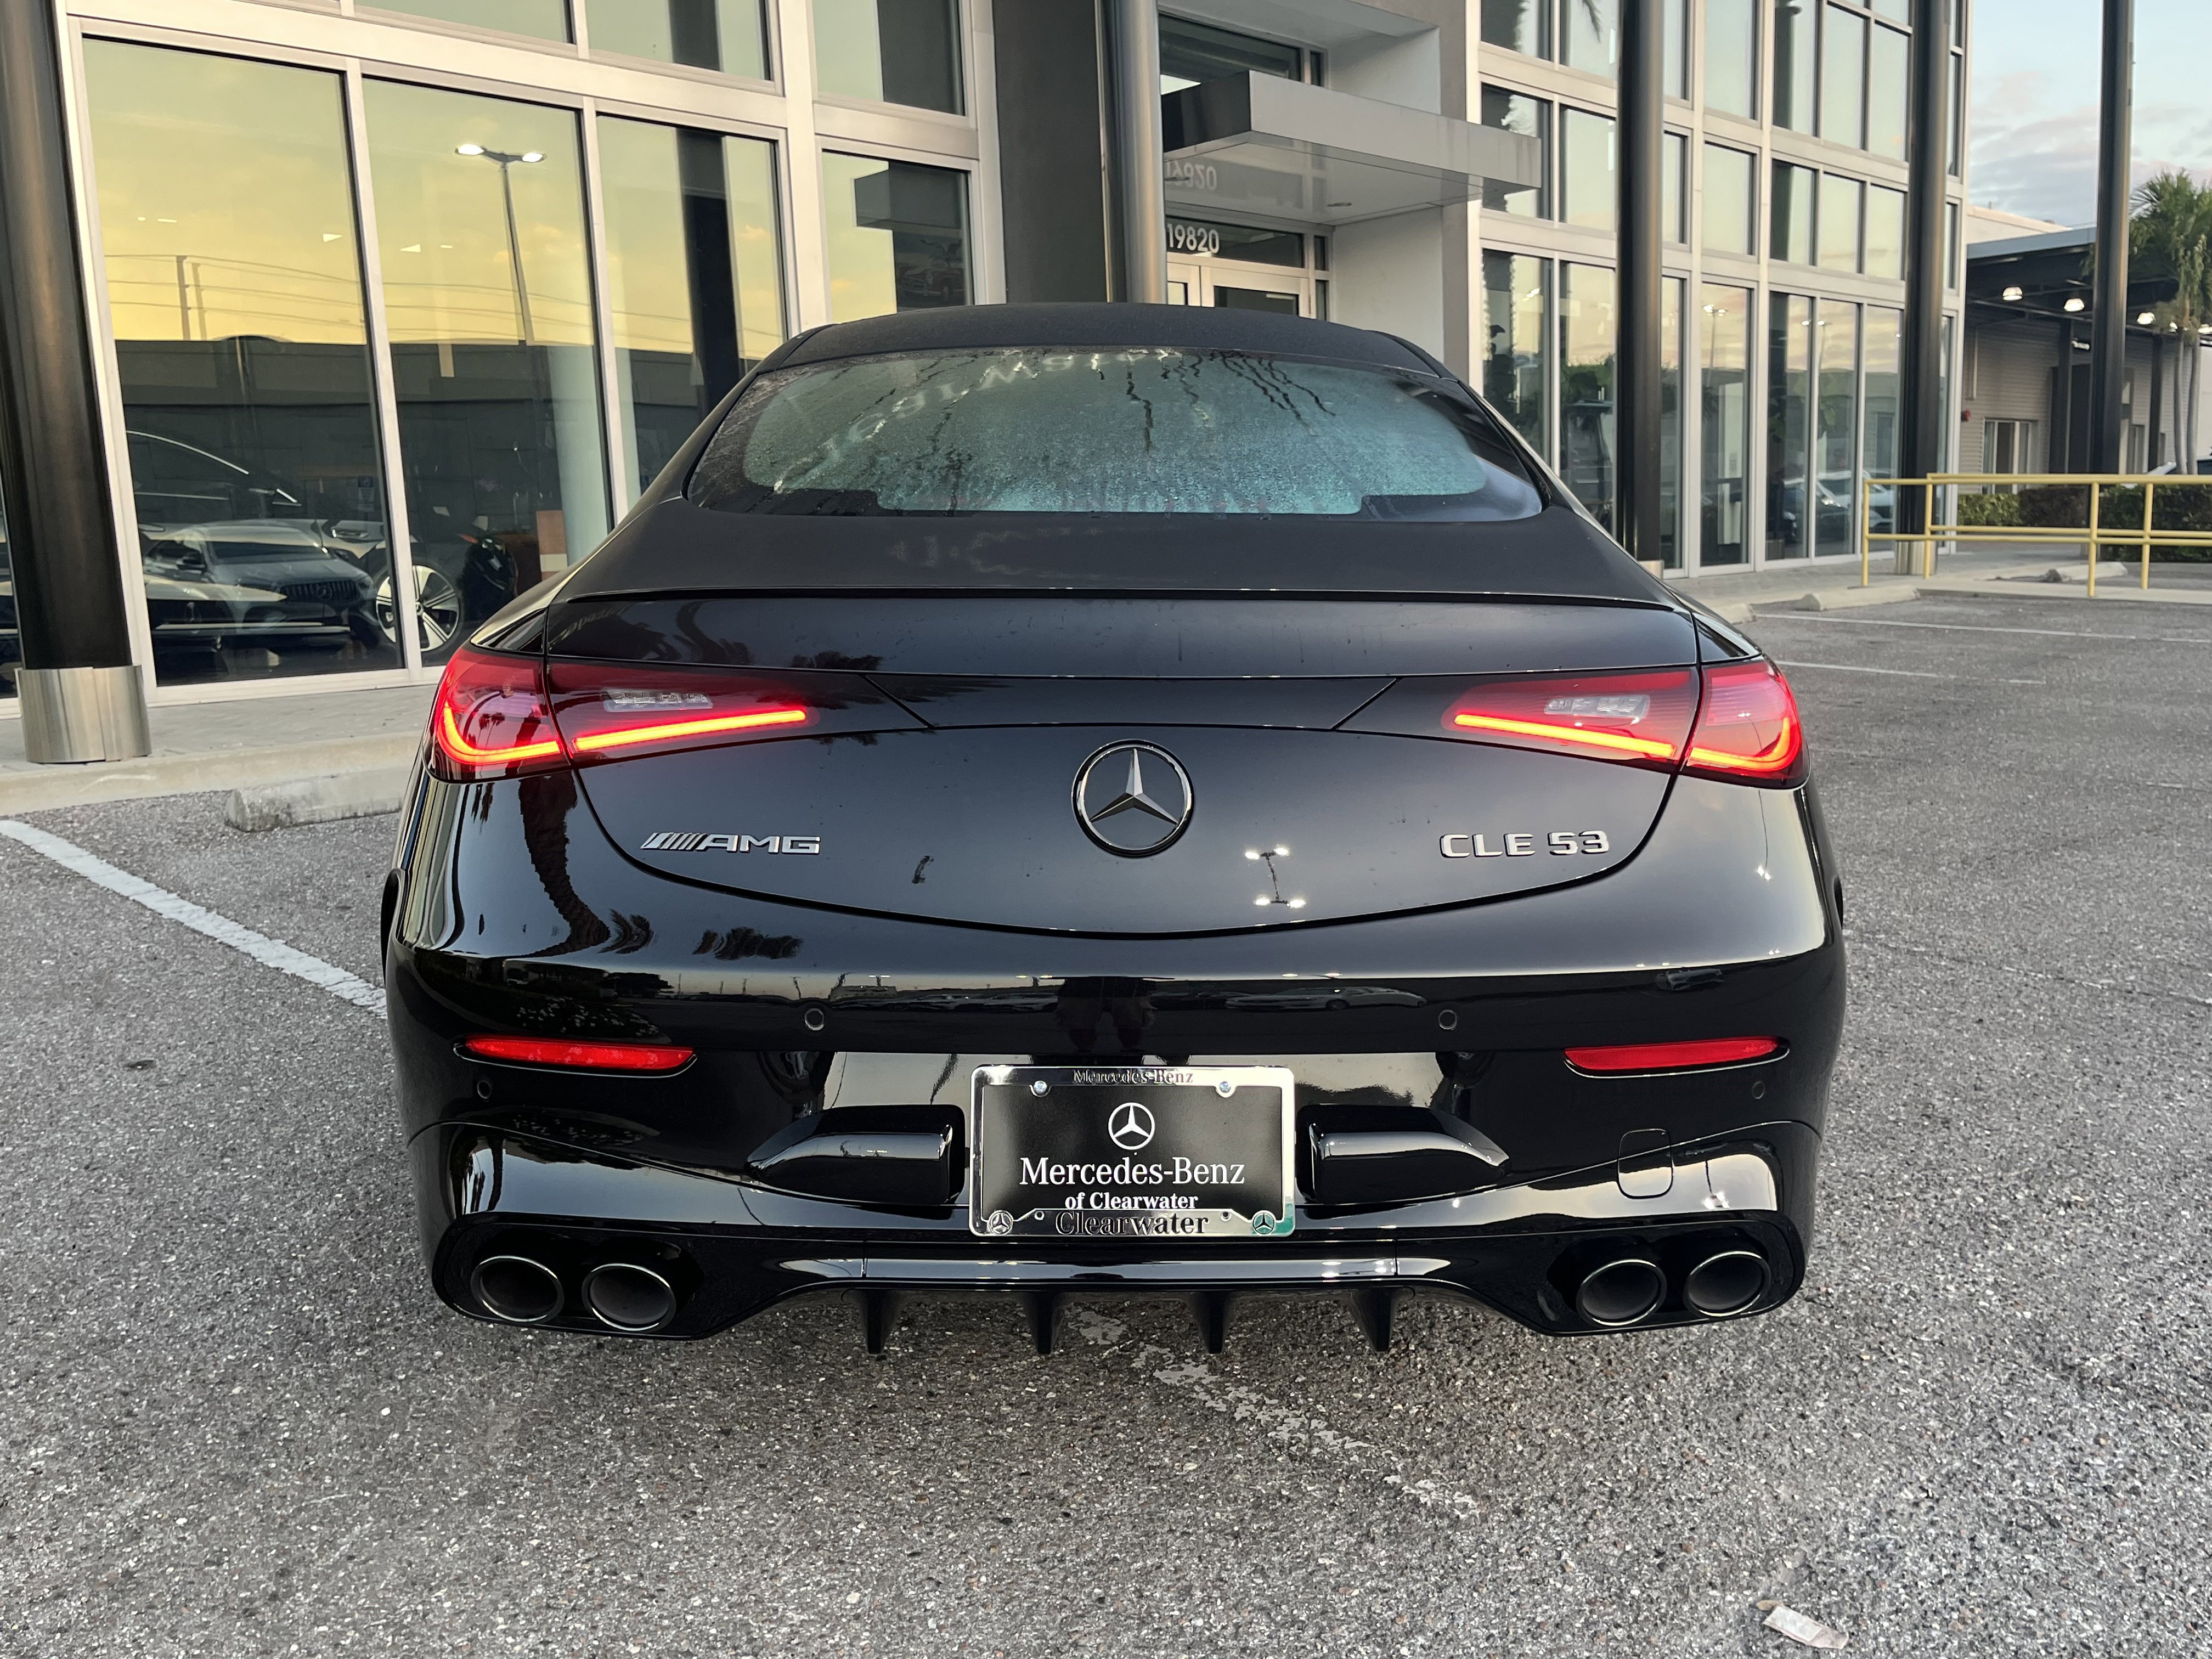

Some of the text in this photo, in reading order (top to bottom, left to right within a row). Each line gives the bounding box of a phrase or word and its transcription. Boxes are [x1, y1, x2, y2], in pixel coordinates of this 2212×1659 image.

[1166, 223, 1220, 253] 19820
[1440, 830, 1609, 857] CLE 53
[1073, 1069, 1194, 1085] Mercedes-Benz
[1019, 1156, 1245, 1185] Mercedes-Benz
[1064, 1192, 1199, 1209] of Clearwater
[1055, 1210, 1210, 1235] Clearwater
